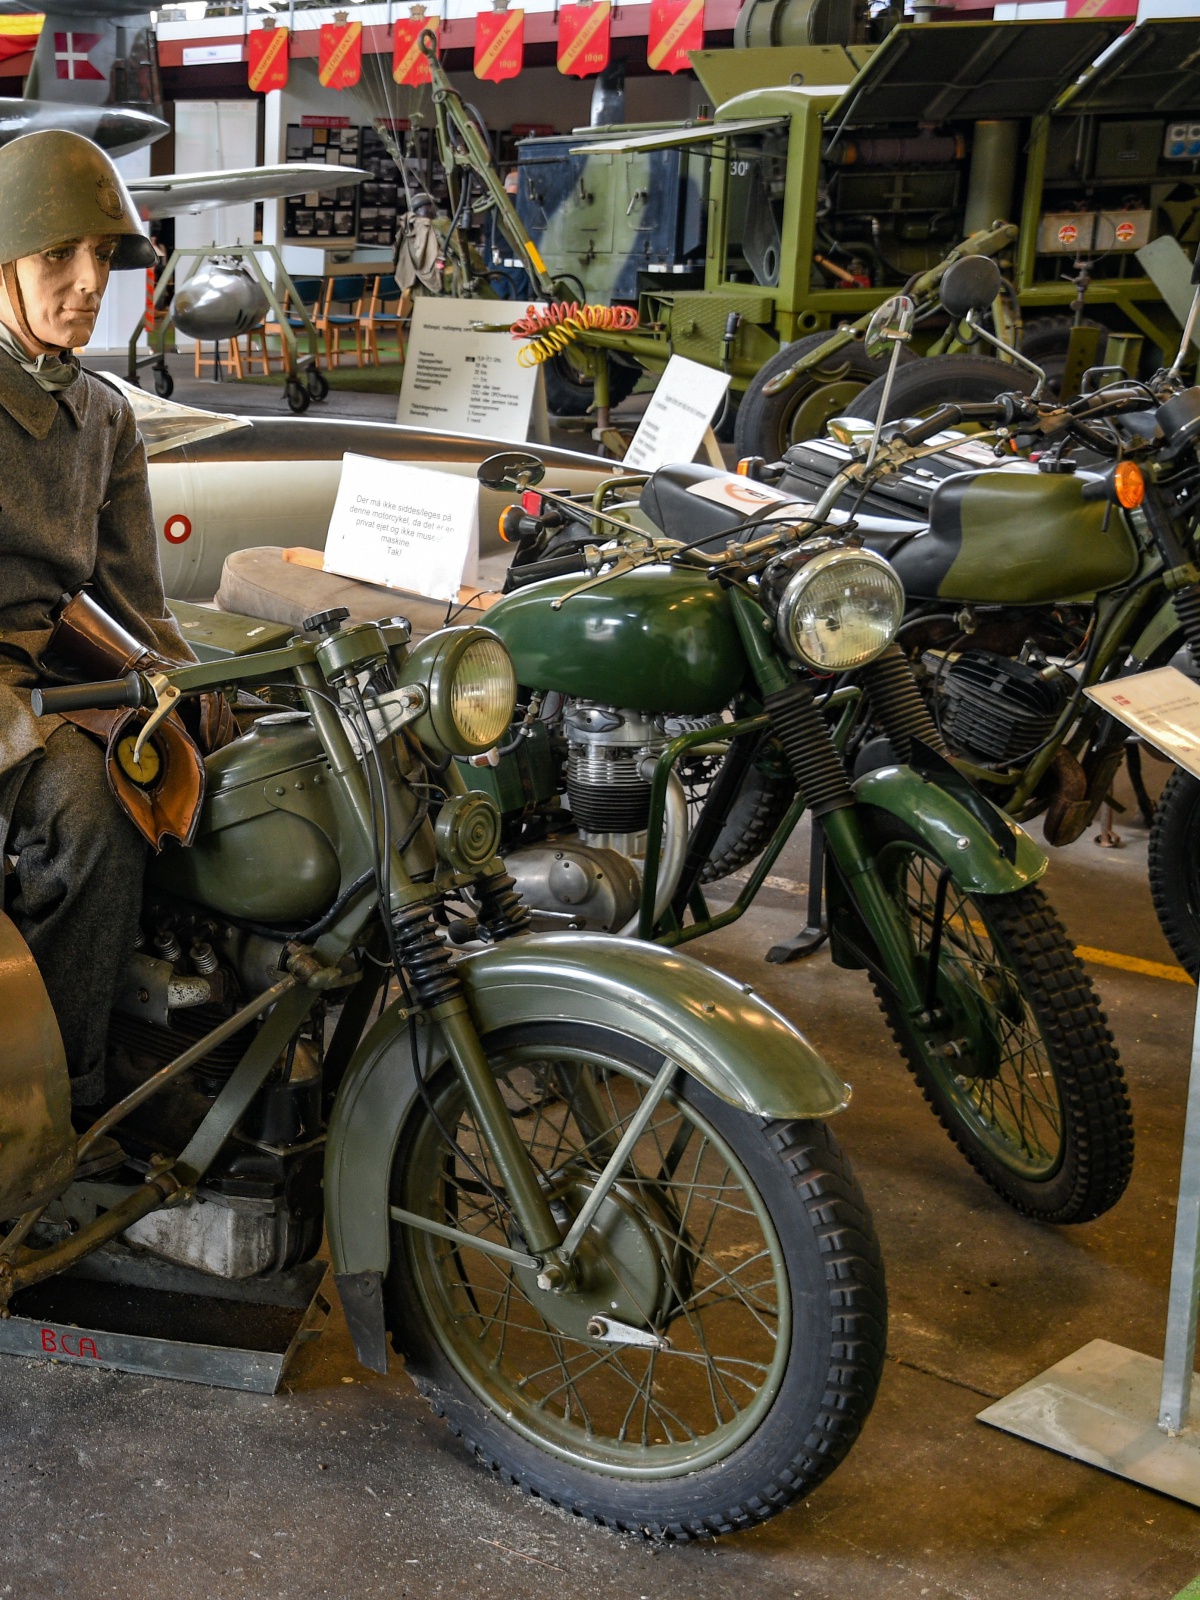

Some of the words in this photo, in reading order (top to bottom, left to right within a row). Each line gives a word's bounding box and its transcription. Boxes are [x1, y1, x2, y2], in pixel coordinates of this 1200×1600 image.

[349, 505, 371, 516] denne
[371, 510, 410, 525] motorcykel,
[412, 517, 422, 527] da
[423, 520, 435, 530] det
[356, 494, 369, 504] Der
[370, 497, 381, 507] må
[382, 500, 397, 510] ikke
[397, 502, 441, 520] siddes/leges
[442, 513, 452, 523] på
[355, 517, 375, 528] privat
[376, 521, 390, 532] ejet
[390, 526, 400, 535] og
[400, 526, 415, 537] ikke
[380, 534, 411, 548] maskine.
[387, 546, 402, 557] Tak!
